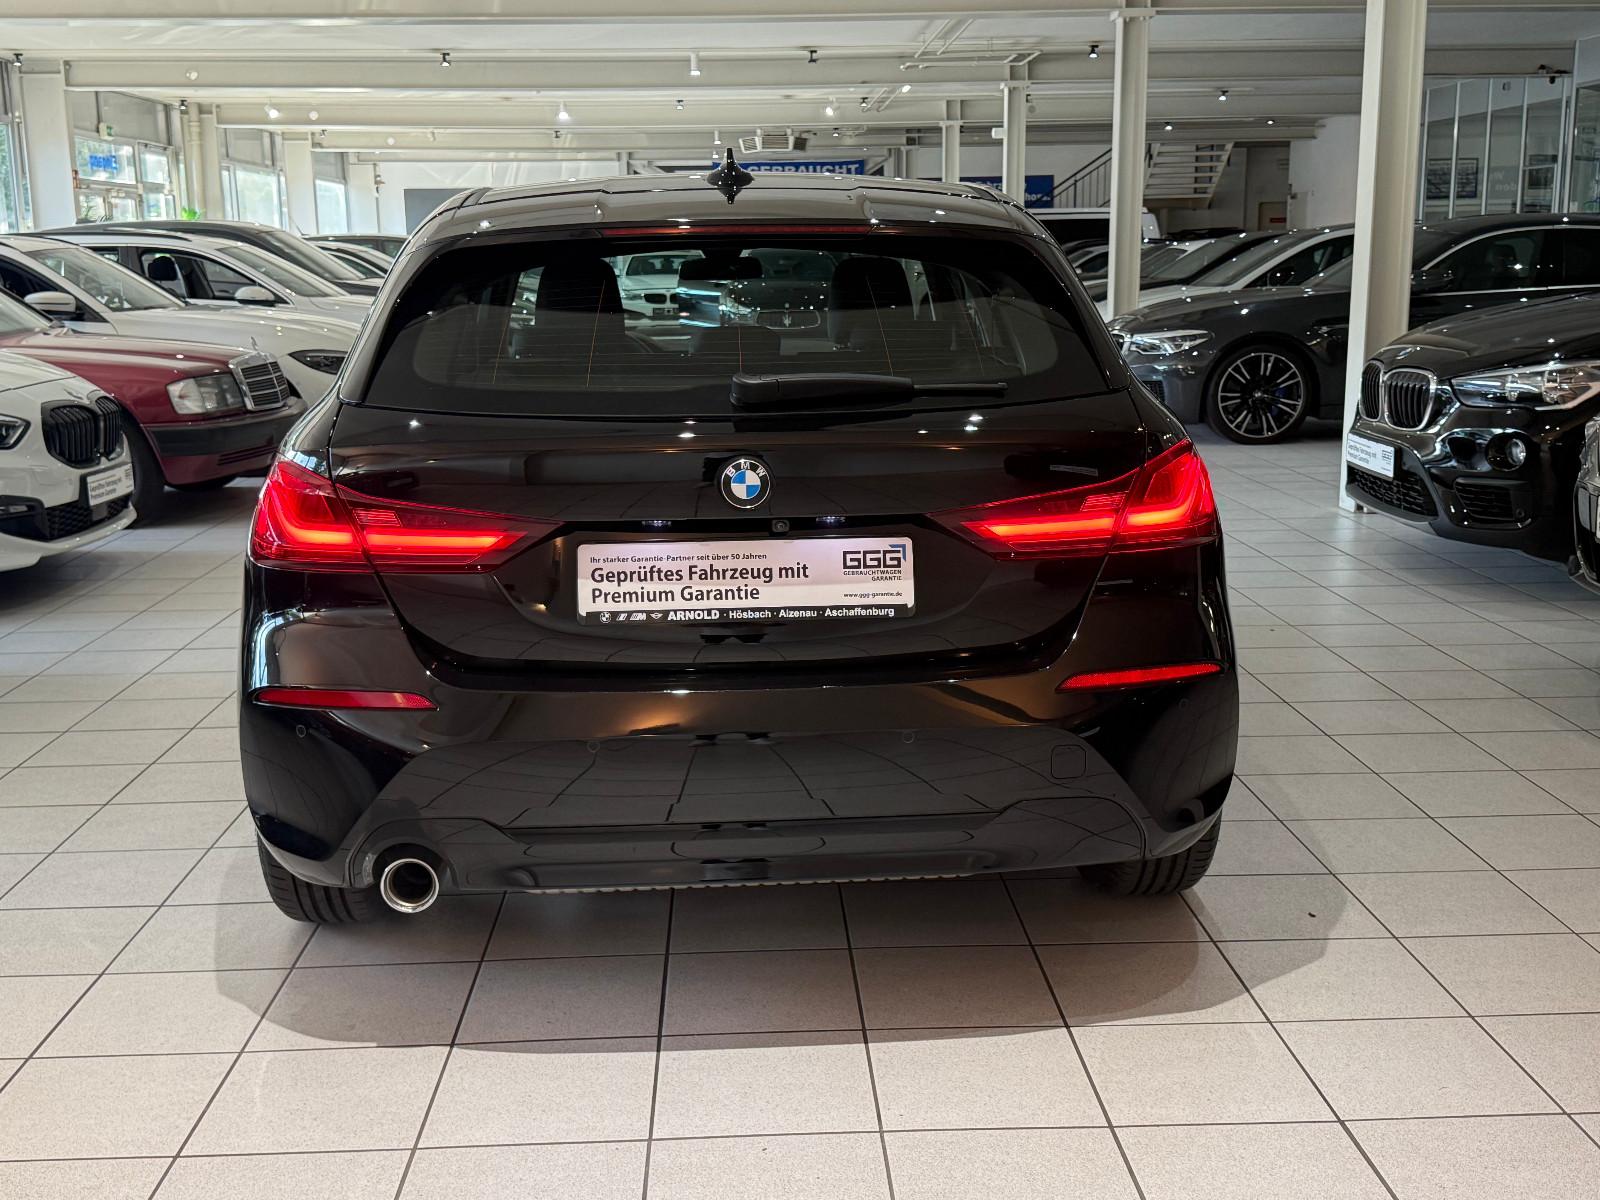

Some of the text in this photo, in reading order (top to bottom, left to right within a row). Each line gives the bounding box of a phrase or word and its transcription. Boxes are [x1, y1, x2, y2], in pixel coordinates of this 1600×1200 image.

[726, 461, 767, 477] BMW
[590, 556, 601, 564] Ihr
[711, 553, 729, 561] über
[843, 550, 902, 569] GGG
[590, 562, 809, 587] Geprüftes Fahrzeug mit
[592, 584, 760, 604] Premium Garantie
[843, 591, 903, 599] www.ggg-garantie.de
[667, 610, 720, 621] ARNOLD
[729, 609, 771, 619] Hösbach
[778, 608, 817, 618] Alzenau
[824, 607, 895, 617] Aschaffenburg
